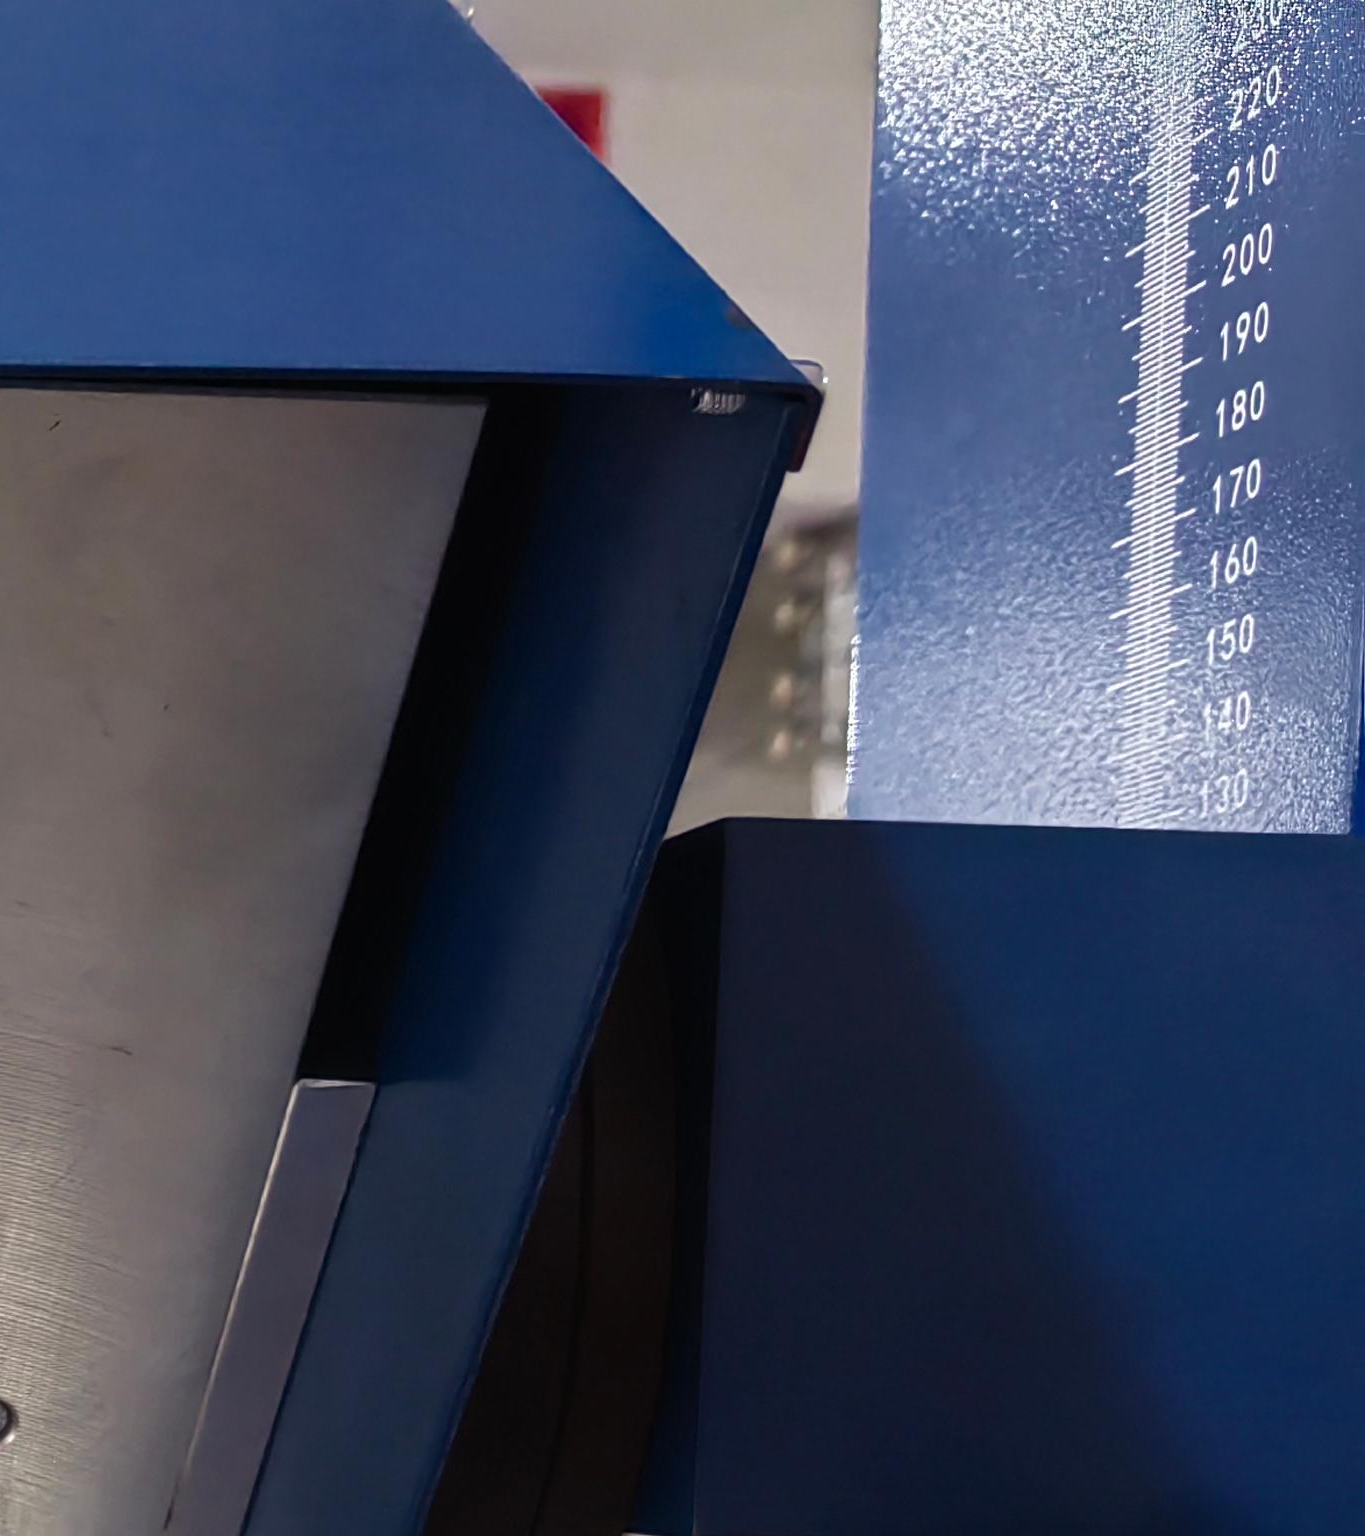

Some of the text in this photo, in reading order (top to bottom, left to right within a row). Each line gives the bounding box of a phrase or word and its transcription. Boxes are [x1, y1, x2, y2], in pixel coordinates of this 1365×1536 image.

[1226, 65, 1280, 131] 220
[1223, 144, 1277, 210] 210
[1221, 223, 1273, 287] 200
[1220, 302, 1269, 361] 190
[1216, 381, 1265, 438] 180
[1213, 459, 1261, 514] 170
[1210, 536, 1258, 589] 160
[1208, 614, 1254, 666] 150
[1203, 691, 1251, 741] 140
[1199, 768, 1248, 819] 130
